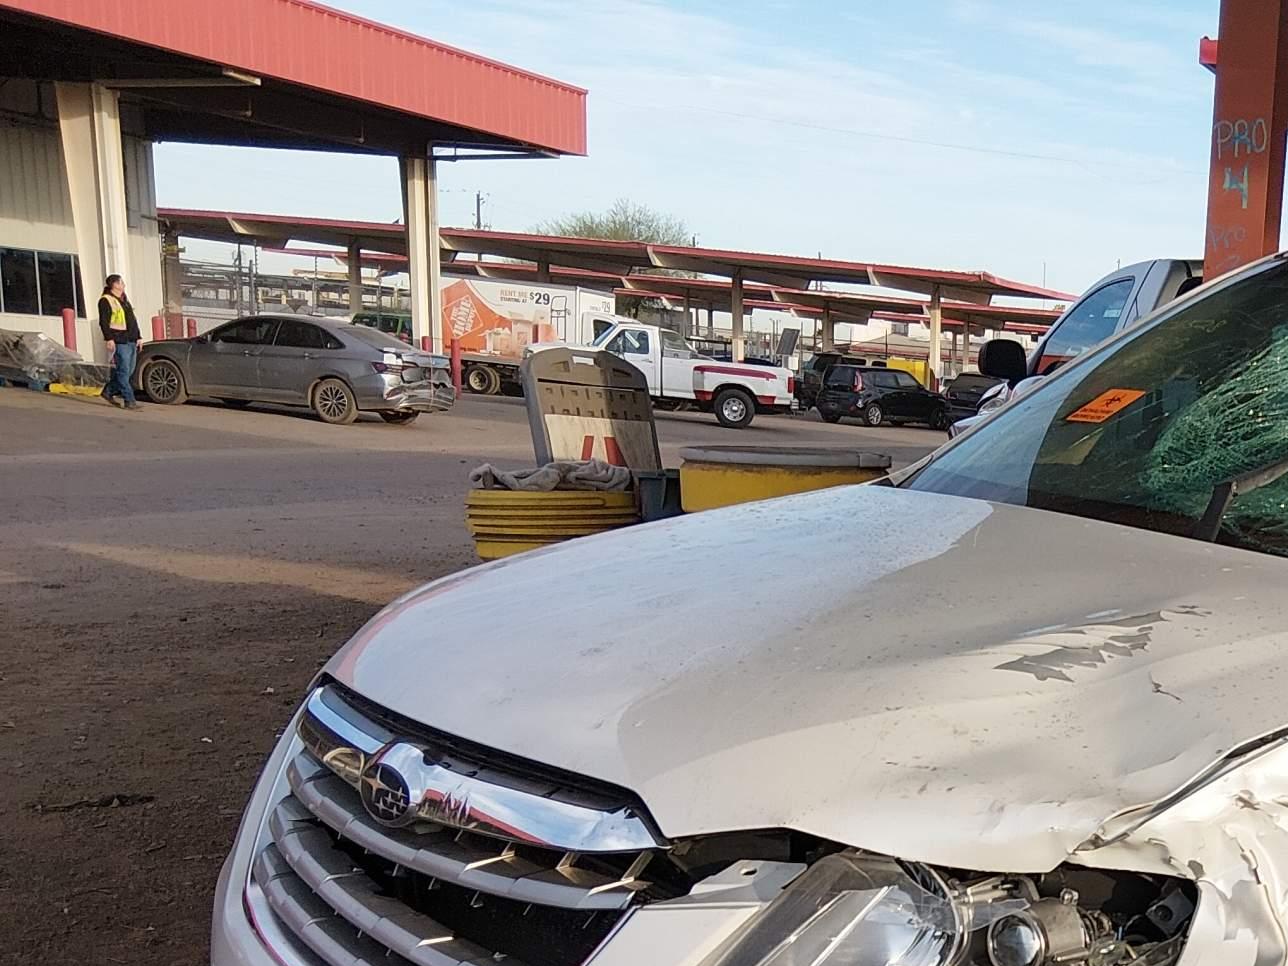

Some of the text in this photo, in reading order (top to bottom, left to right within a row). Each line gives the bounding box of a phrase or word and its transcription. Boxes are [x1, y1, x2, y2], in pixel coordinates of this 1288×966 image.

[1214, 118, 1267, 160] PRO
[1223, 163, 1248, 209] 4
[530, 291, 550, 305] $29
